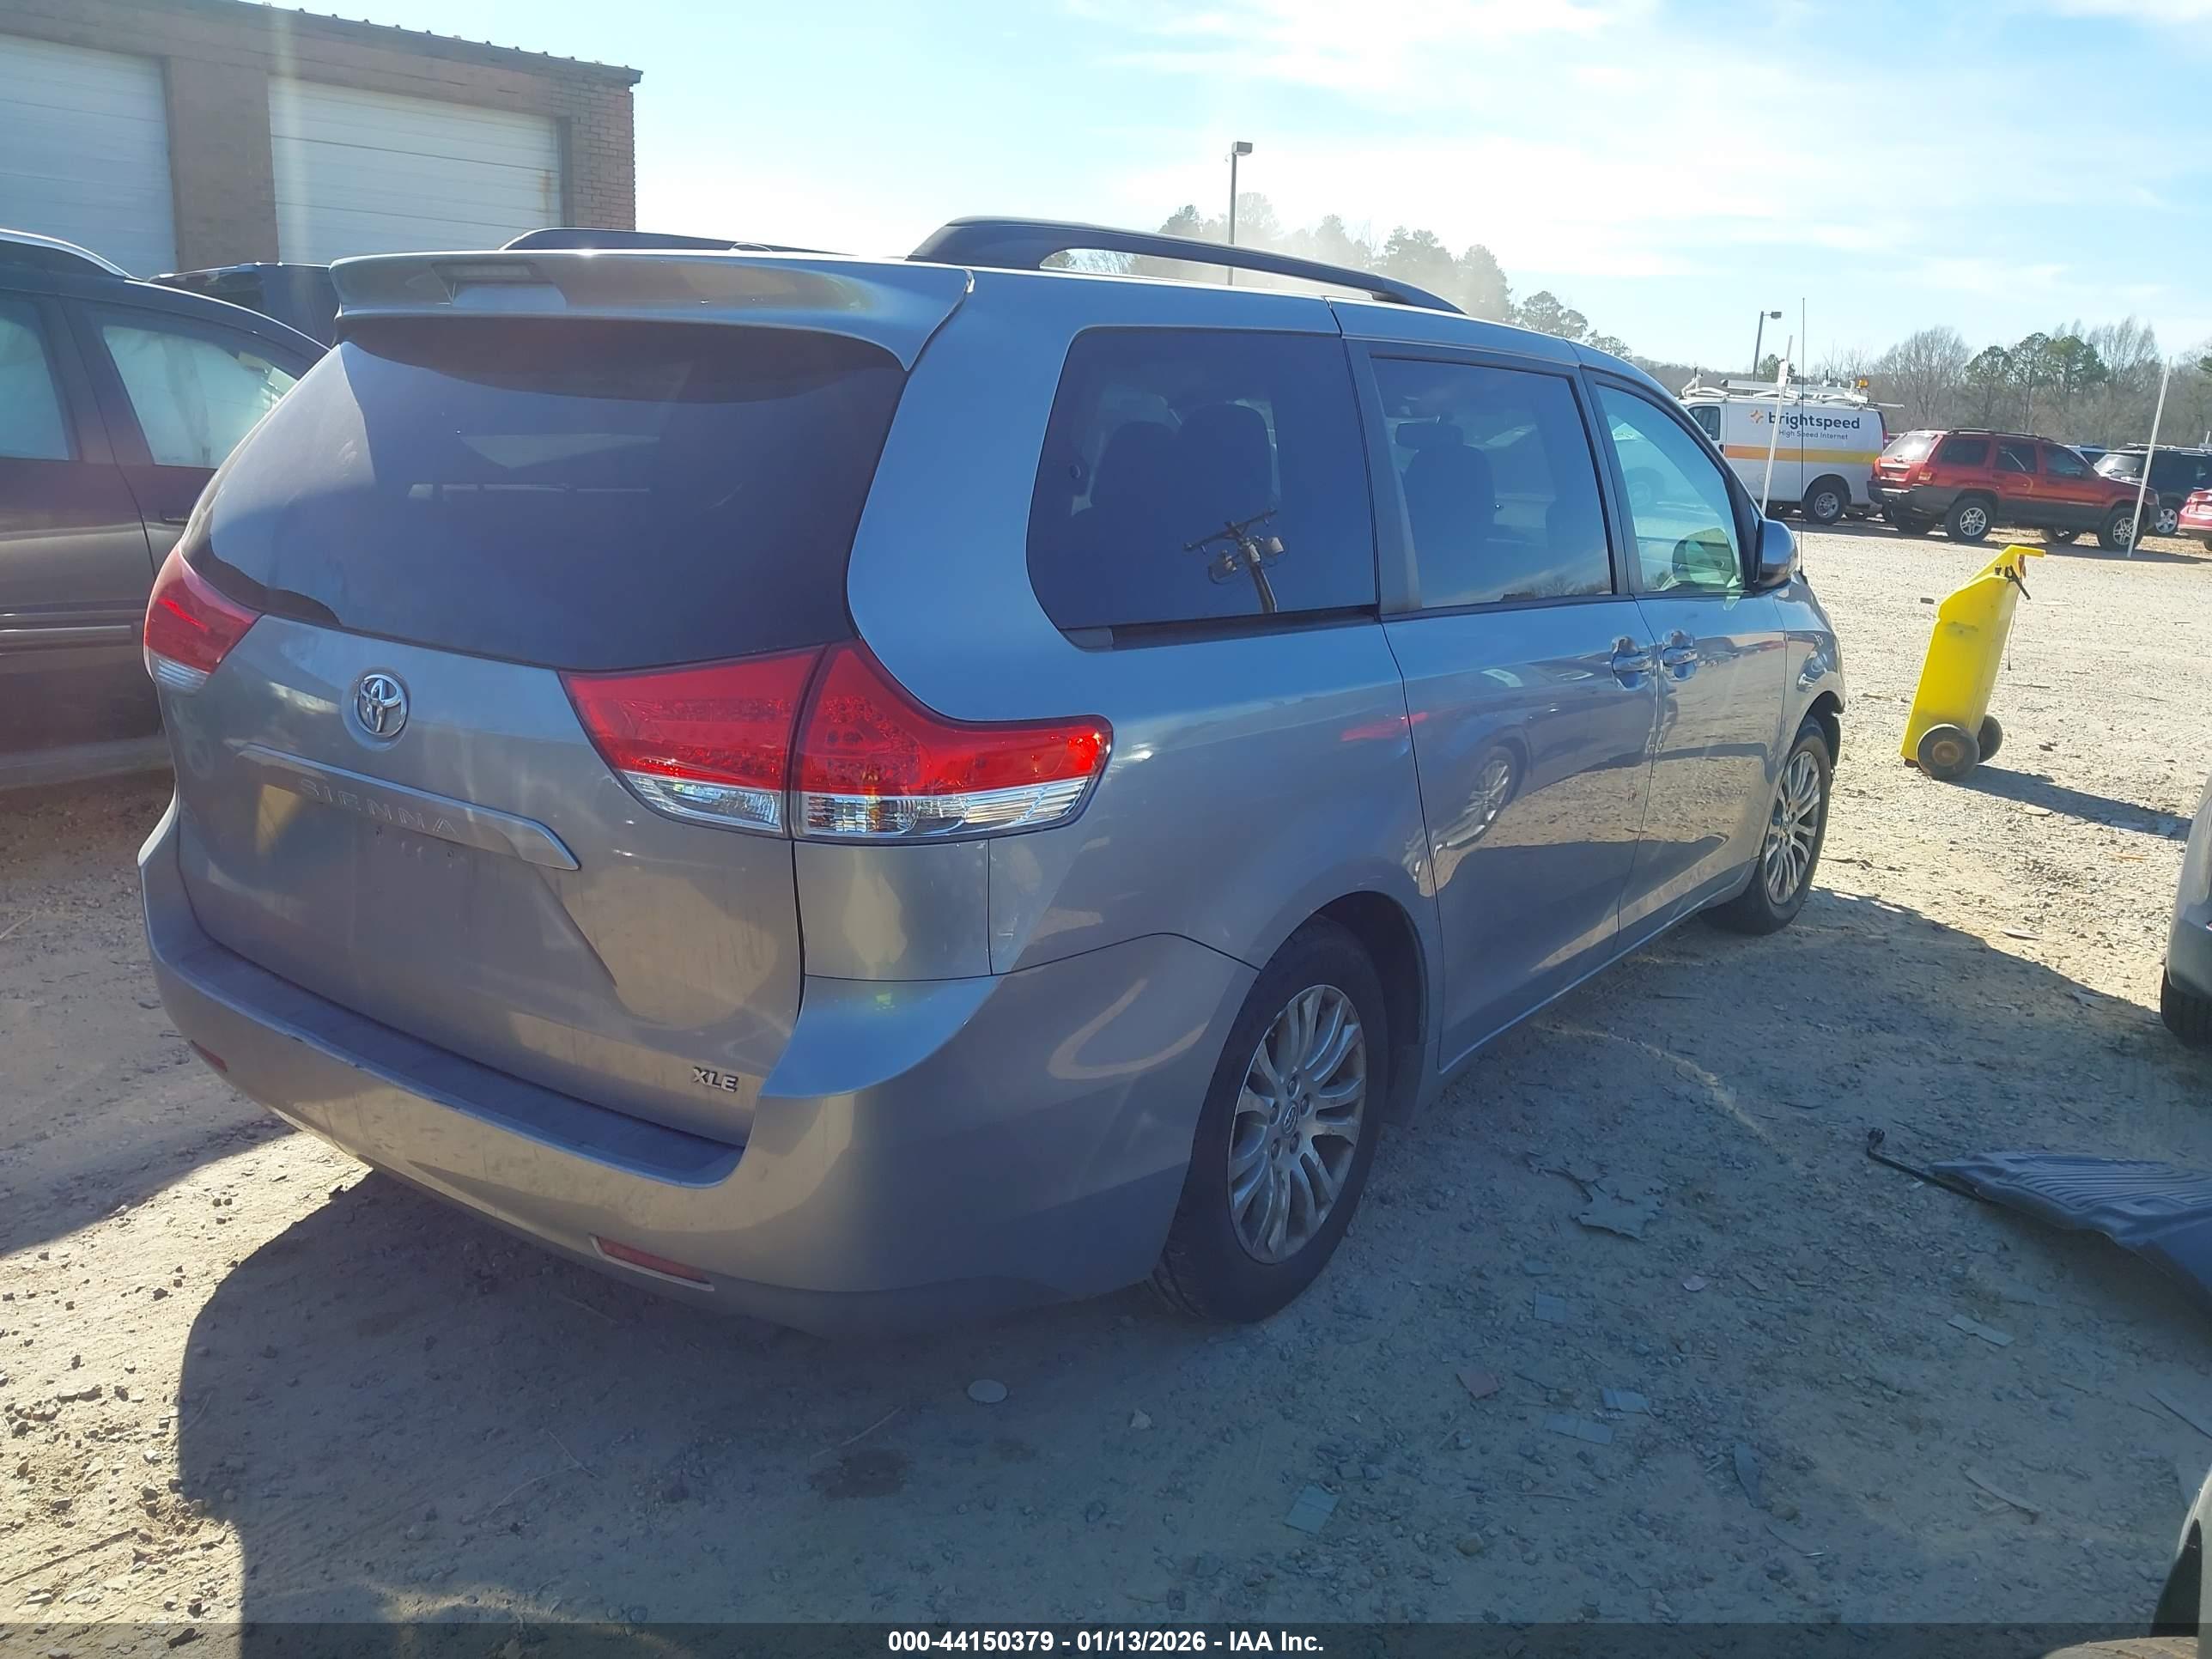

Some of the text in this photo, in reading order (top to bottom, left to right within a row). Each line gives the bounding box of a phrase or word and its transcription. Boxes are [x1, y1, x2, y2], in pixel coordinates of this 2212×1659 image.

[1768, 411, 1861, 430] brightspeed
[1778, 429, 1796, 439] High
[1820, 432, 1848, 441] Internet
[693, 1066, 738, 1093] XLE
